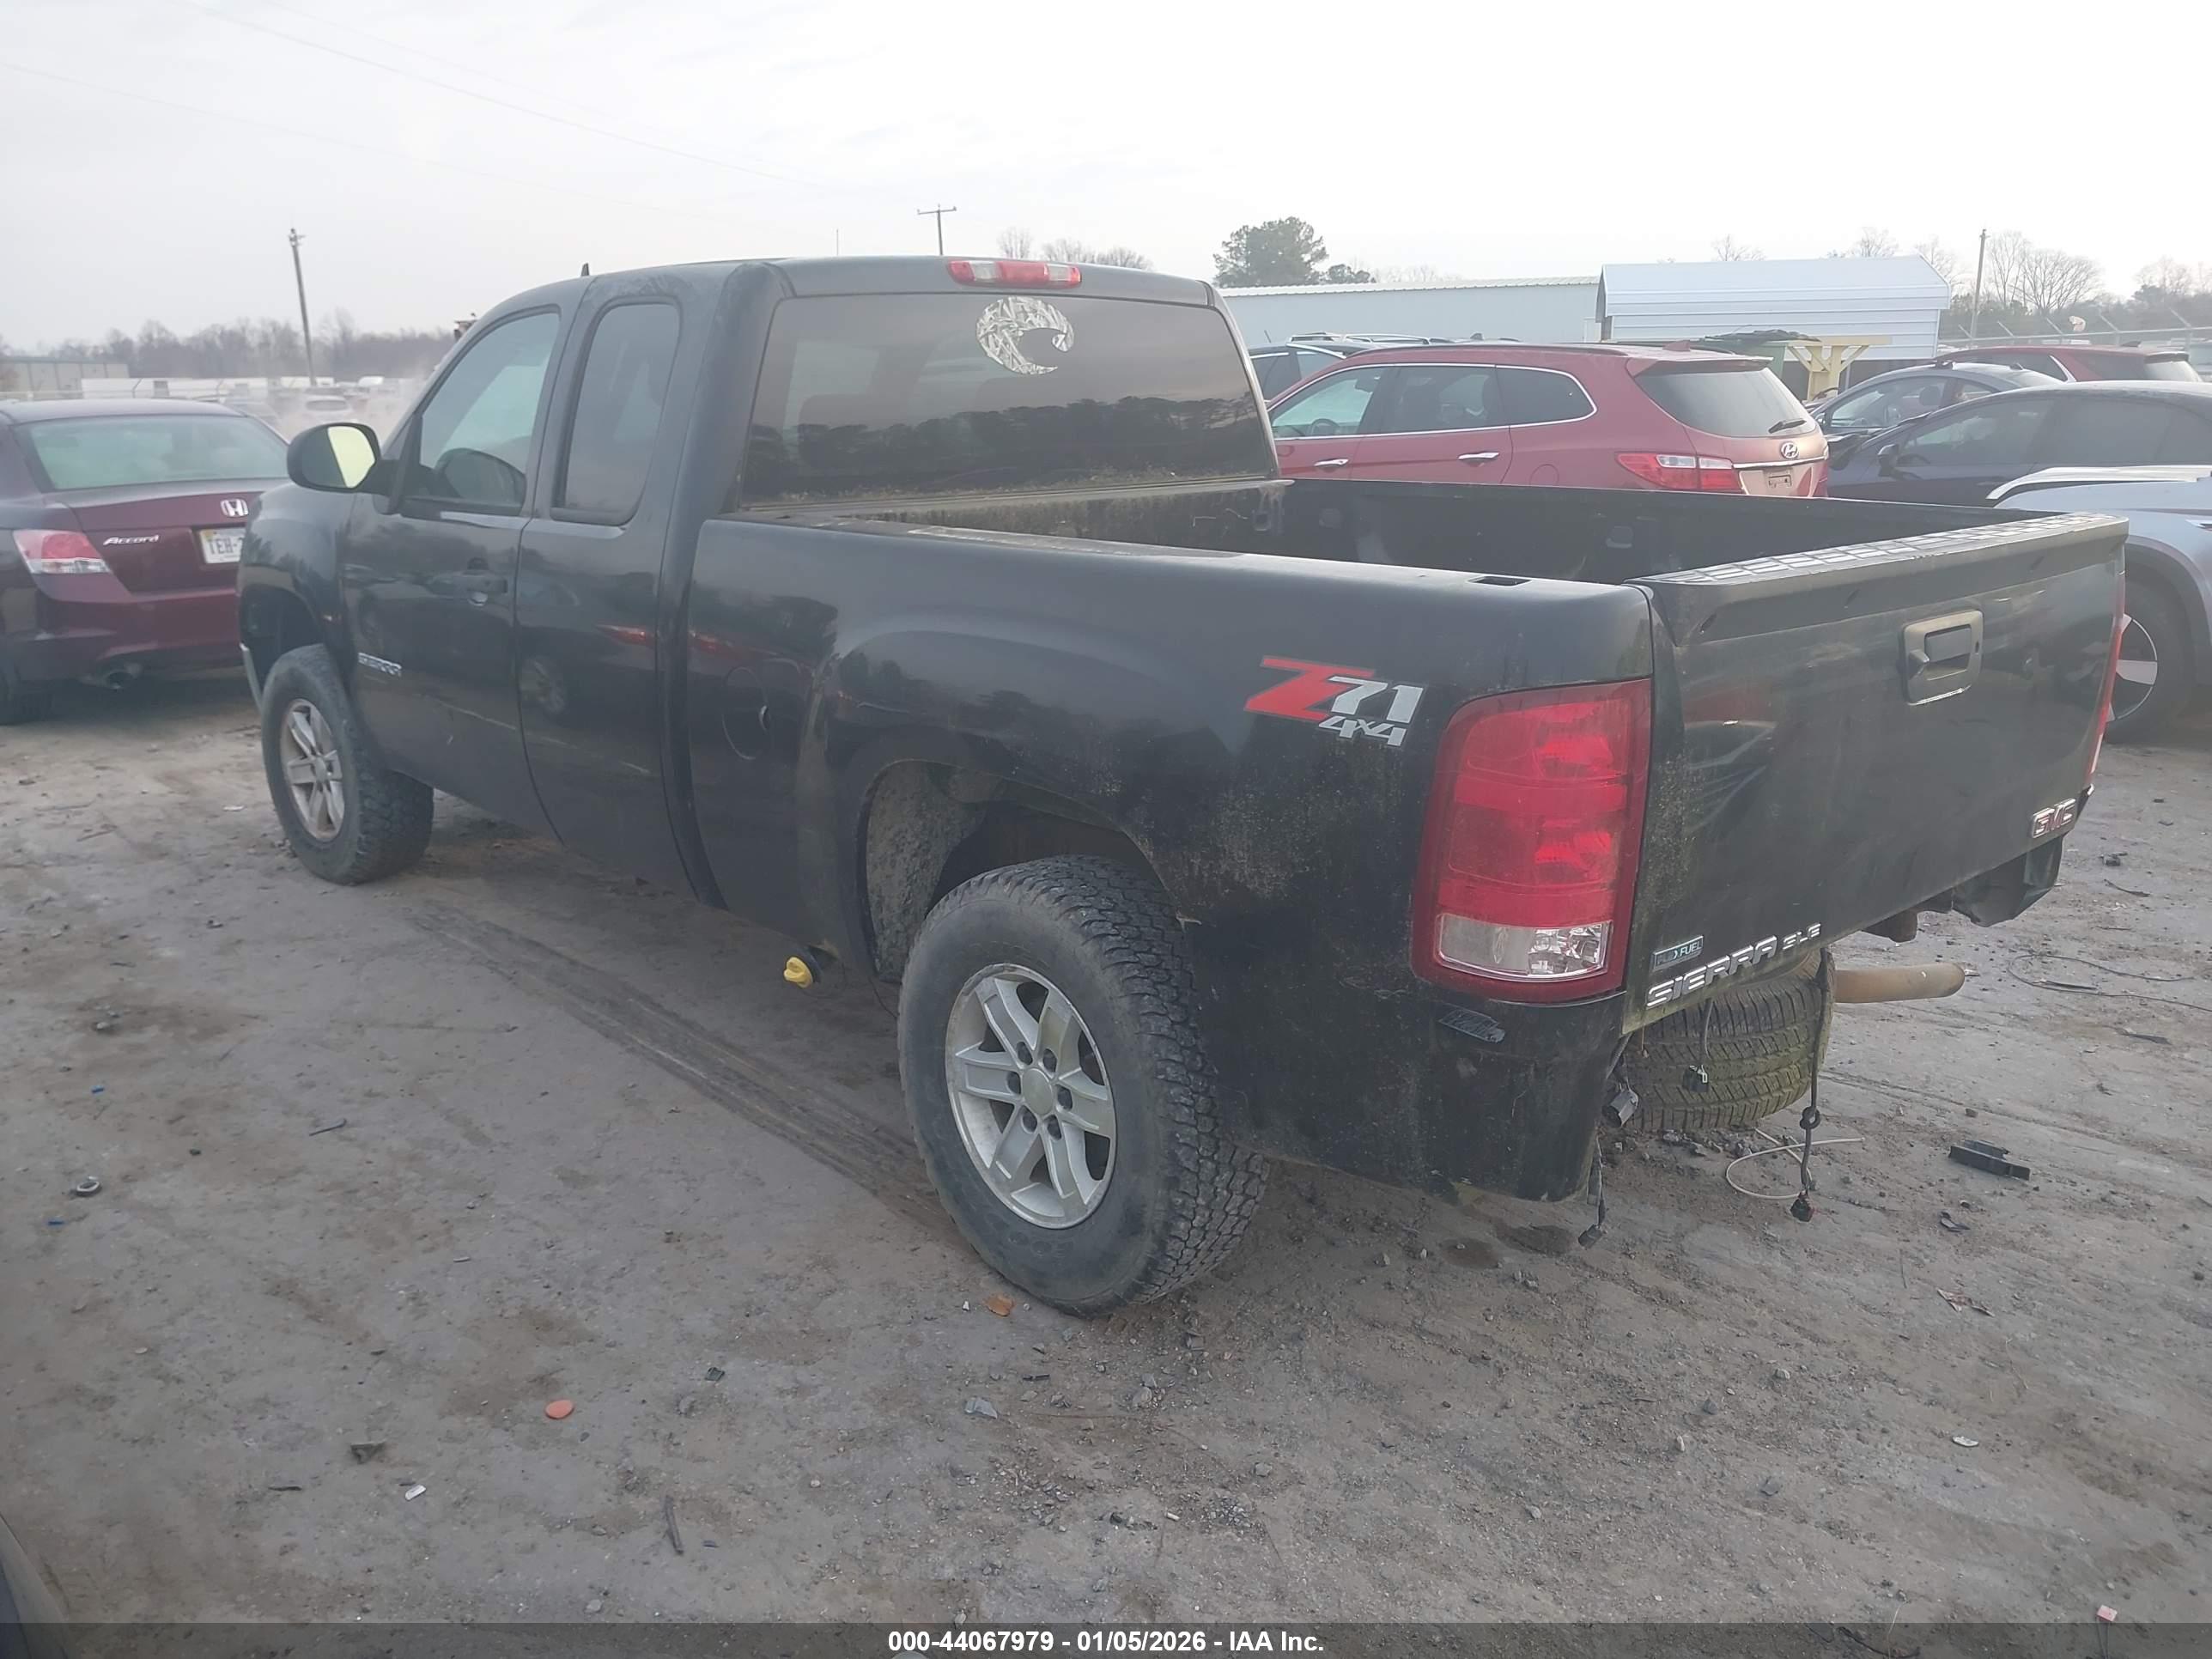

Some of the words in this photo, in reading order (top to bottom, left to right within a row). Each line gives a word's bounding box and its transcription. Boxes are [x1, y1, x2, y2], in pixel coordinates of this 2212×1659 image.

[102, 534, 160, 546] Accord
[1245, 656, 1424, 724] Z71
[2033, 799, 2076, 838] GMC
[1645, 935, 1778, 1009] SIERRA
[1782, 923, 1821, 950] SLE
